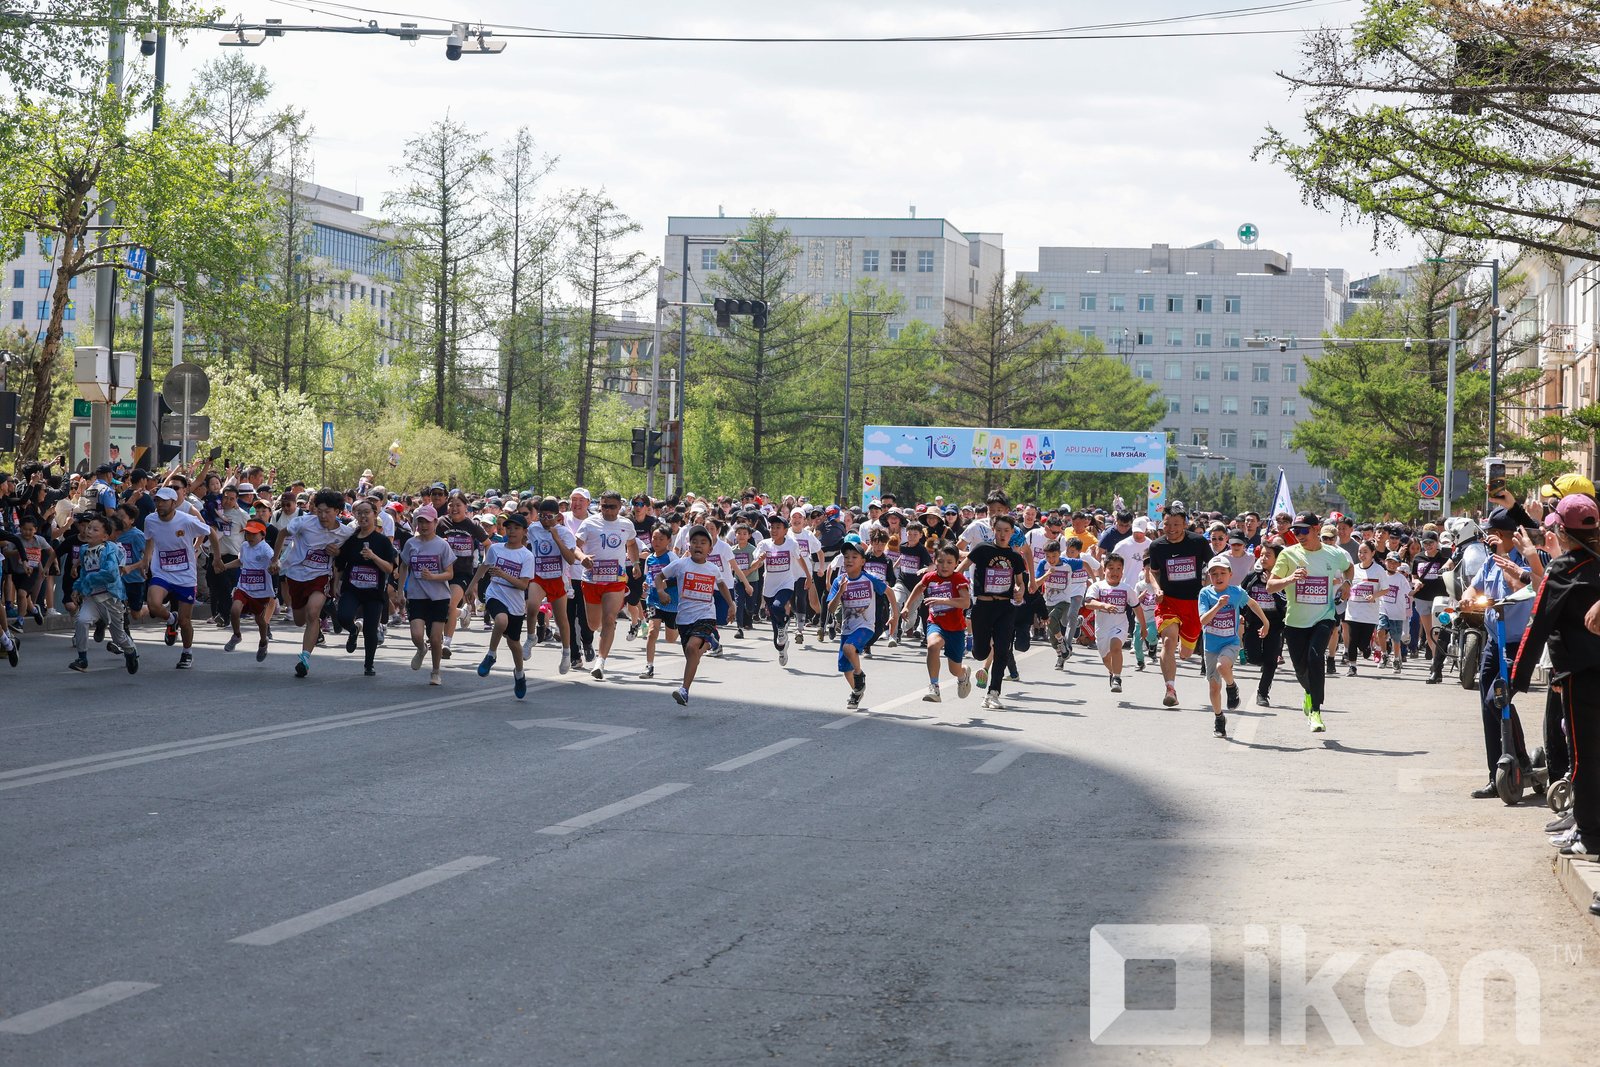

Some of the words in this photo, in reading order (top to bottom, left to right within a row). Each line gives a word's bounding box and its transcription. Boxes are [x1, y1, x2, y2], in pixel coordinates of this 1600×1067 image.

[979, 432, 1051, 453] ГАРАА
[1065, 446, 1081, 454] APU
[1081, 446, 1104, 454] DAIRY
[1126, 450, 1147, 458] SHARK
[1174, 563, 1195, 572] 28684
[1304, 585, 1327, 594] 26825
[848, 590, 869, 600] 34185
[1213, 618, 1234, 628] 26824
